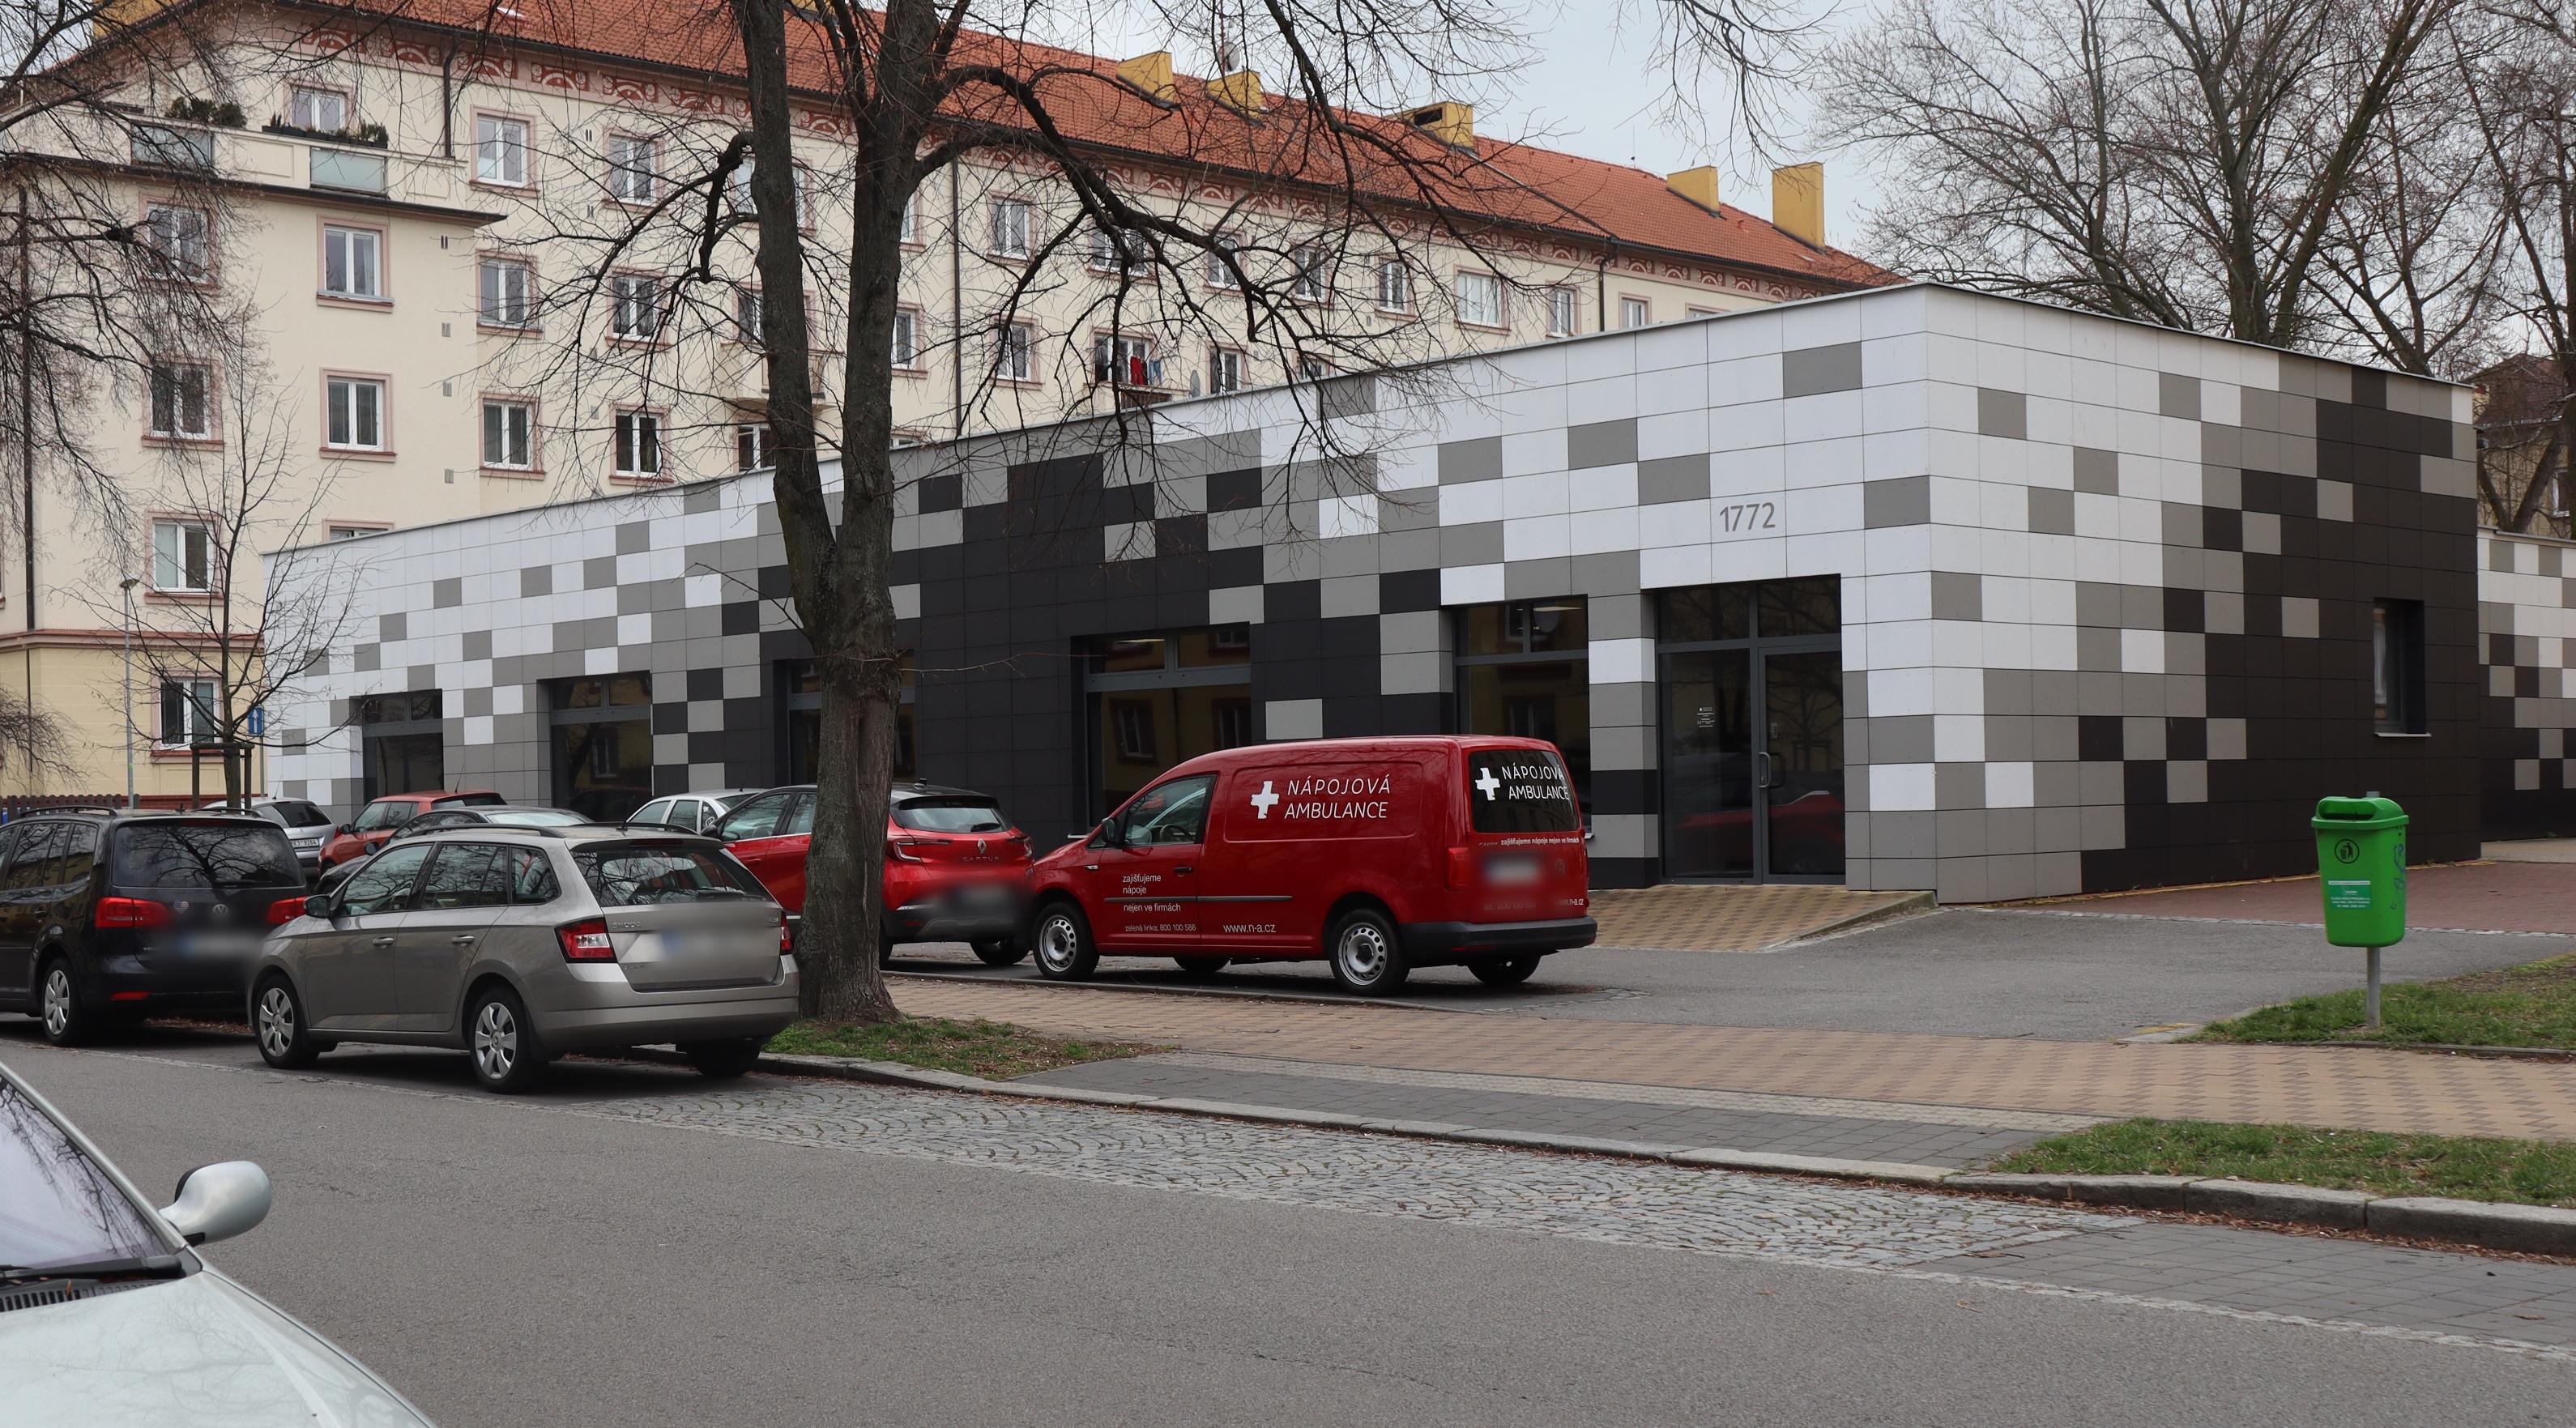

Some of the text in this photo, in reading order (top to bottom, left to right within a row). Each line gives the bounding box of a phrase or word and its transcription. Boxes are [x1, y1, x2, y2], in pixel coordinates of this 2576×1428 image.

[1719, 501, 1776, 532] 1772
[1500, 762, 1565, 780] NÁPOJOVÁ
[1286, 774, 1391, 795] NÁPOJOVÁ
[1508, 785, 1570, 800] AMBULANCE
[1284, 801, 1388, 819] AMBULANCE
[1122, 873, 1162, 883] zajišťujeme
[1123, 885, 1147, 895] nápoje
[1124, 903, 1143, 913] nejen
[1154, 902, 1181, 912] firmách
[1125, 923, 1143, 931] zelená
[1159, 923, 1171, 931] 800
[1173, 923, 1184, 931] 100
[1223, 923, 1277, 933] www.n-a.cz
